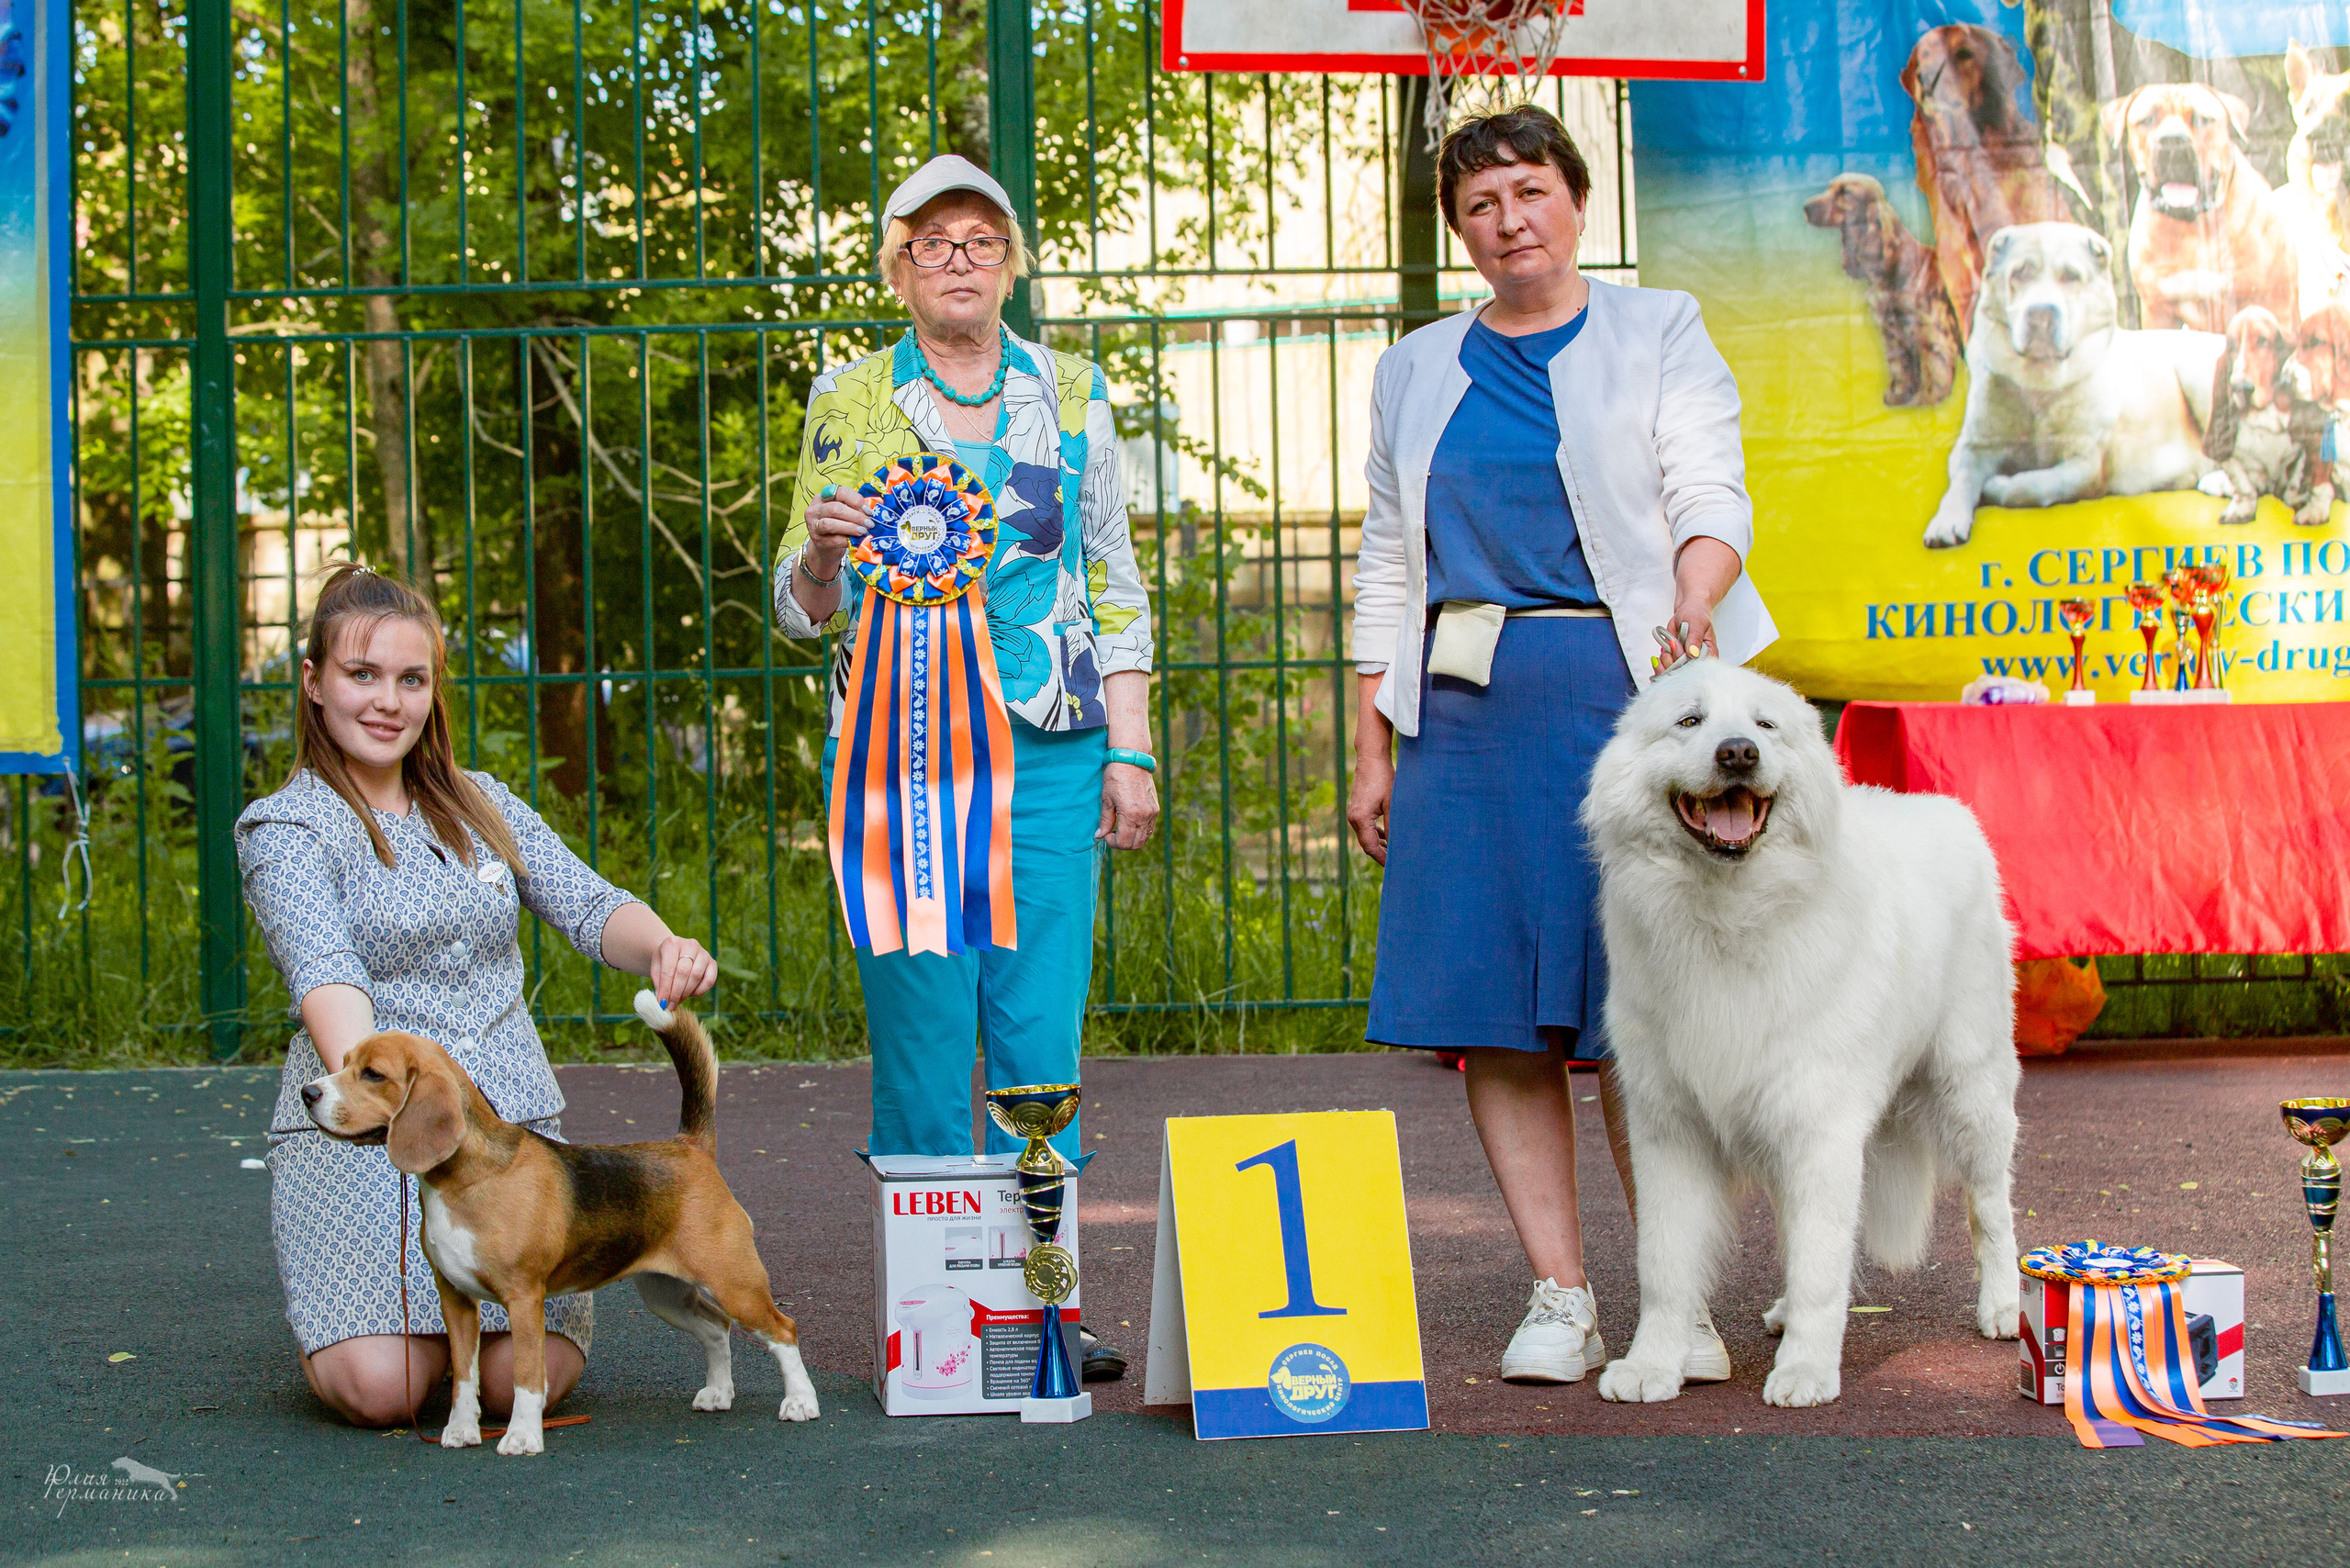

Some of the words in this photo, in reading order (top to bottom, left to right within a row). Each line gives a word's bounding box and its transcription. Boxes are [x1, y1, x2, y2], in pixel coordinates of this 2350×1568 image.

[910, 532, 938, 541] ДРУГ
[1980, 562, 2013, 588] г.
[2027, 543, 2264, 587] СЕРГИЕВ
[2282, 540, 2350, 576] ПО
[1864, 588, 2344, 640] КИНОЛГЕСКИ
[893, 1191, 981, 1215] LEBEN
[1235, 1138, 1348, 1319] 1
[1281, 1349, 1314, 1365] СЕРГИЕВ
[1315, 1350, 1338, 1371] ПОСАД
[1289, 1384, 1337, 1401] ДРУГ
